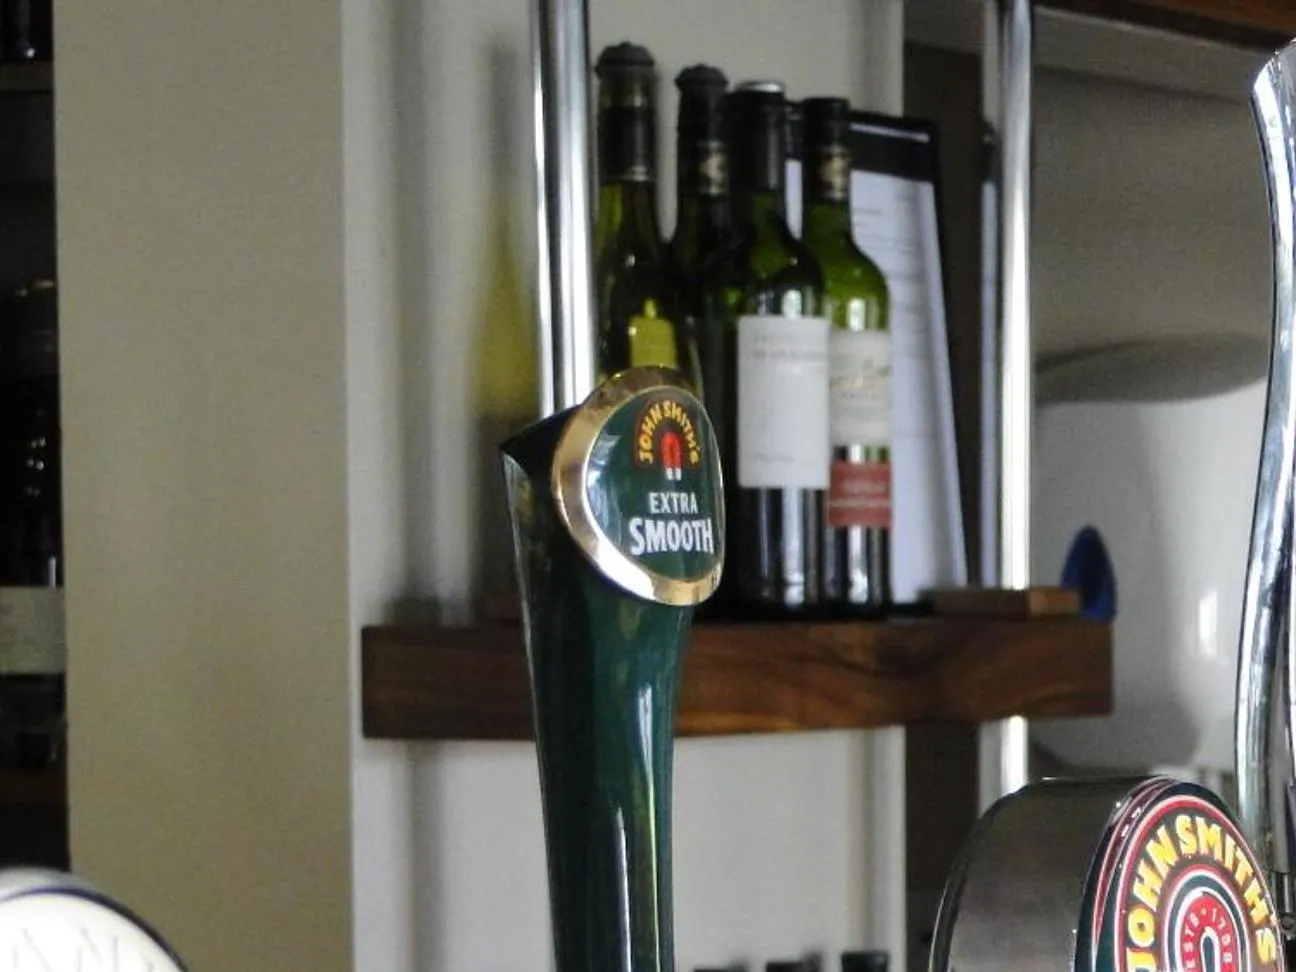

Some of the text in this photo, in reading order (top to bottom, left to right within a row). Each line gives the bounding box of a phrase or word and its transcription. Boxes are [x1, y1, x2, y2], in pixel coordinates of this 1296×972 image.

[639, 407, 663, 465] JOHN
[649, 492, 699, 514] EXTRA
[628, 516, 714, 556] SMOOTH
[1175, 814, 1278, 965] SMITH'S
